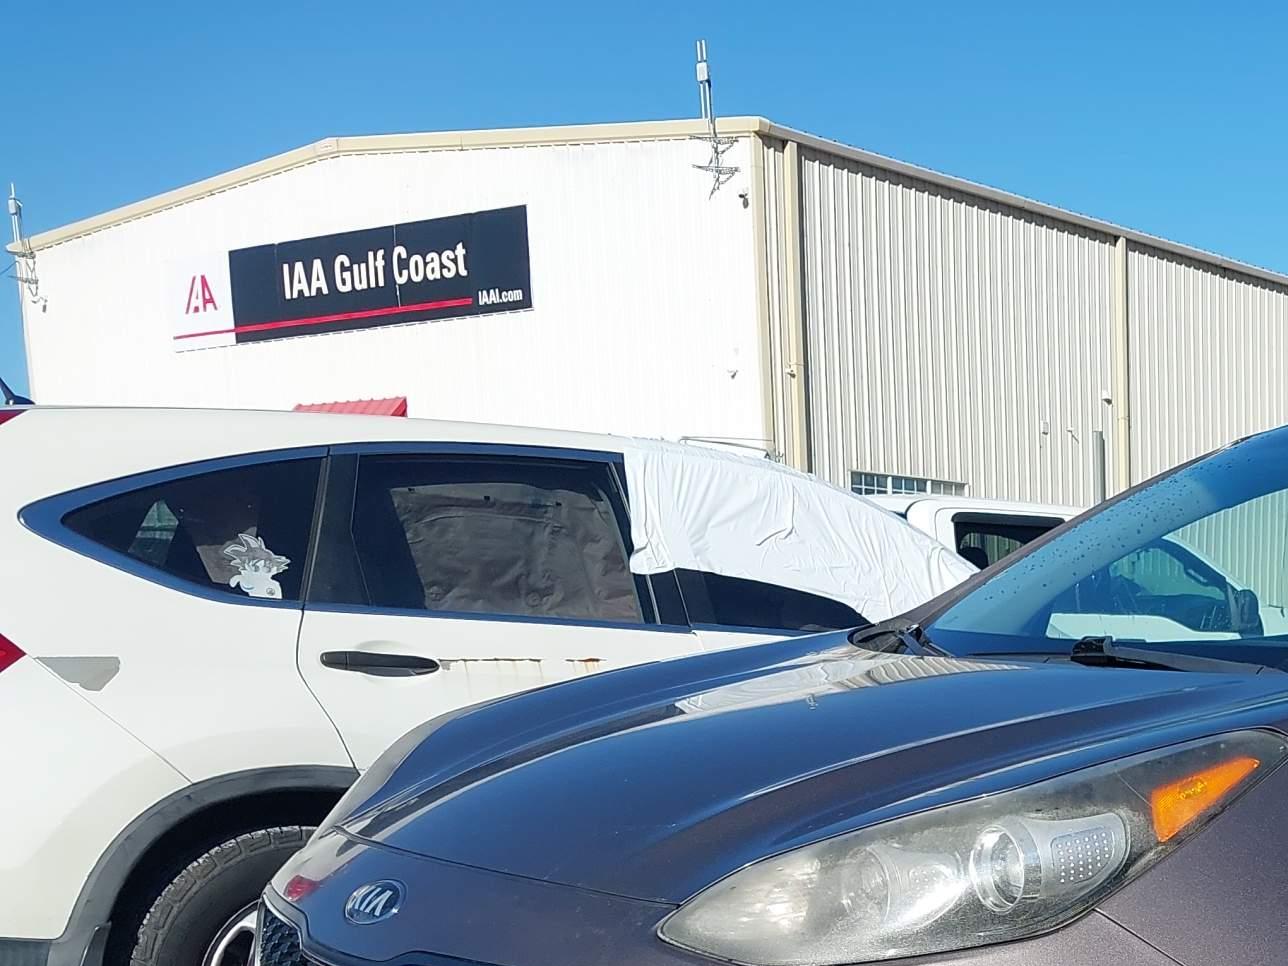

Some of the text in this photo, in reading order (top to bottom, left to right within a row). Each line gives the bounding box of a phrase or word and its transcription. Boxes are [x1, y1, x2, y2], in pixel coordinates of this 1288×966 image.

[282, 241, 468, 300] IAA Gulf Coast
[347, 885, 393, 917] KIA
